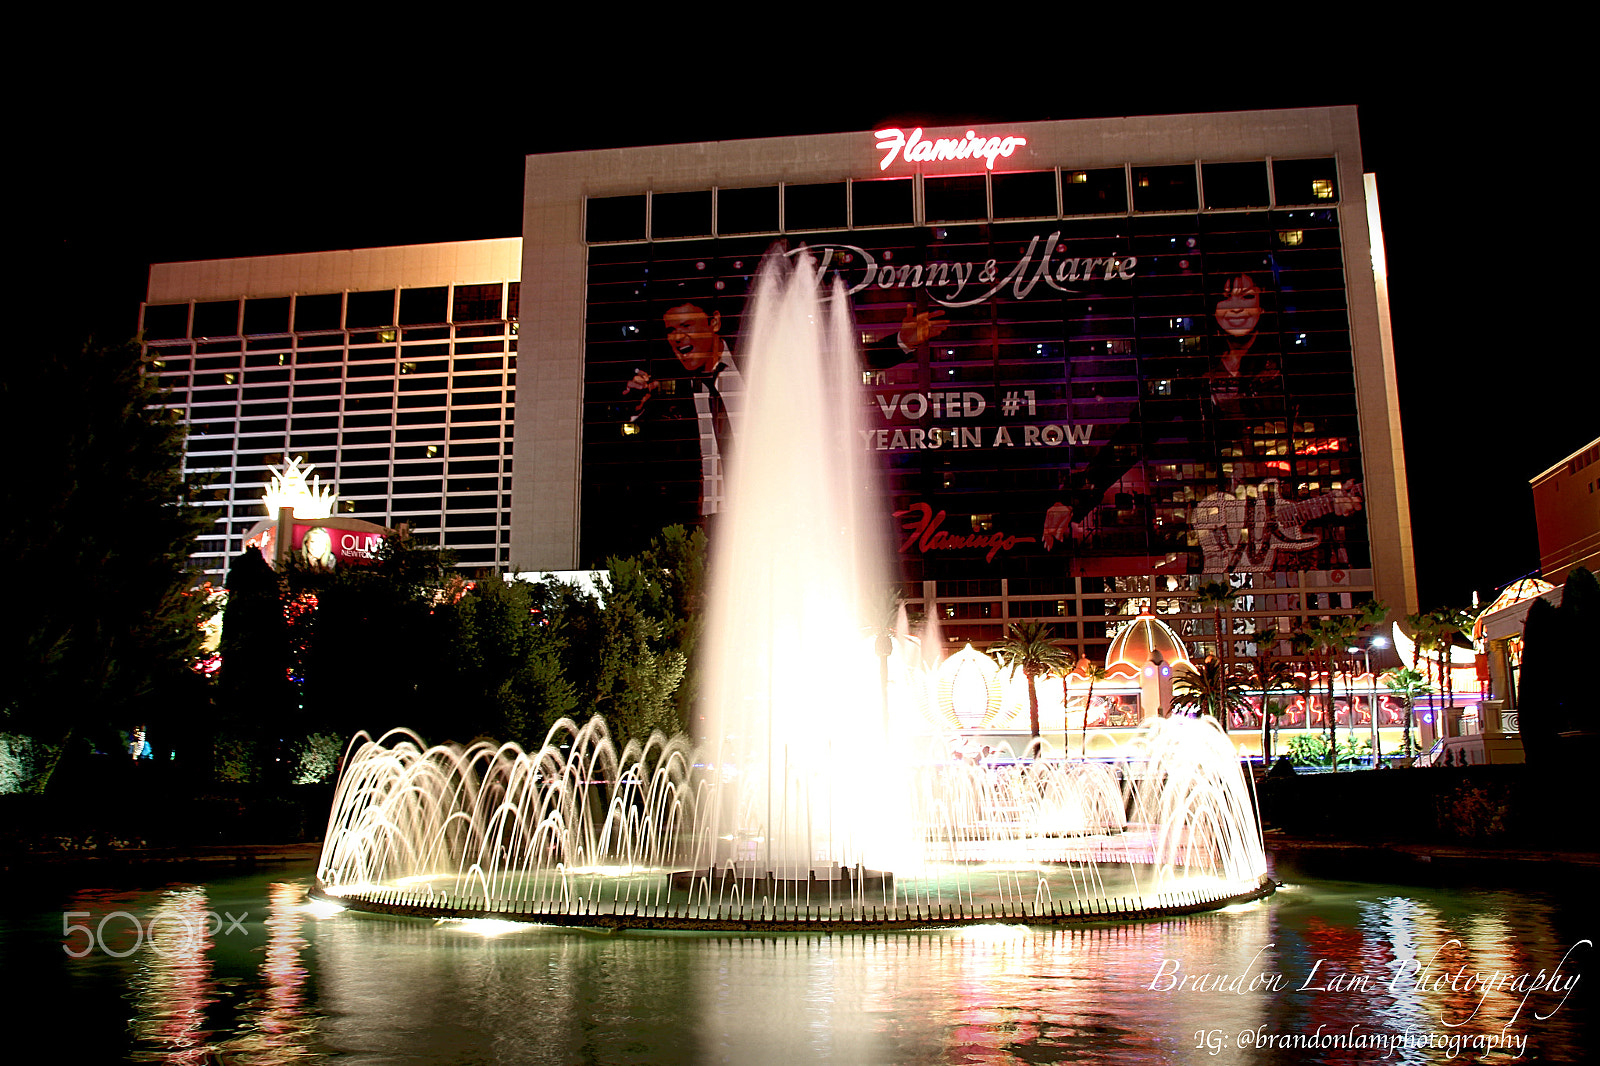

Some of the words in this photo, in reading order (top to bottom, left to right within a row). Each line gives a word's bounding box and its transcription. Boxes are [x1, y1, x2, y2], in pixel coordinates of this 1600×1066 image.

[874, 127, 1027, 170] Flamingo
[783, 244, 972, 301] Donny
[925, 231, 1137, 308] Marie
[979, 259, 998, 284] &
[876, 392, 986, 420] VOTED
[1002, 390, 1036, 416] #1
[857, 427, 943, 450] YEARS
[953, 426, 982, 448] IN
[993, 426, 1014, 447] A
[1024, 424, 1094, 446] ROW
[891, 502, 1036, 563] Flamingo
